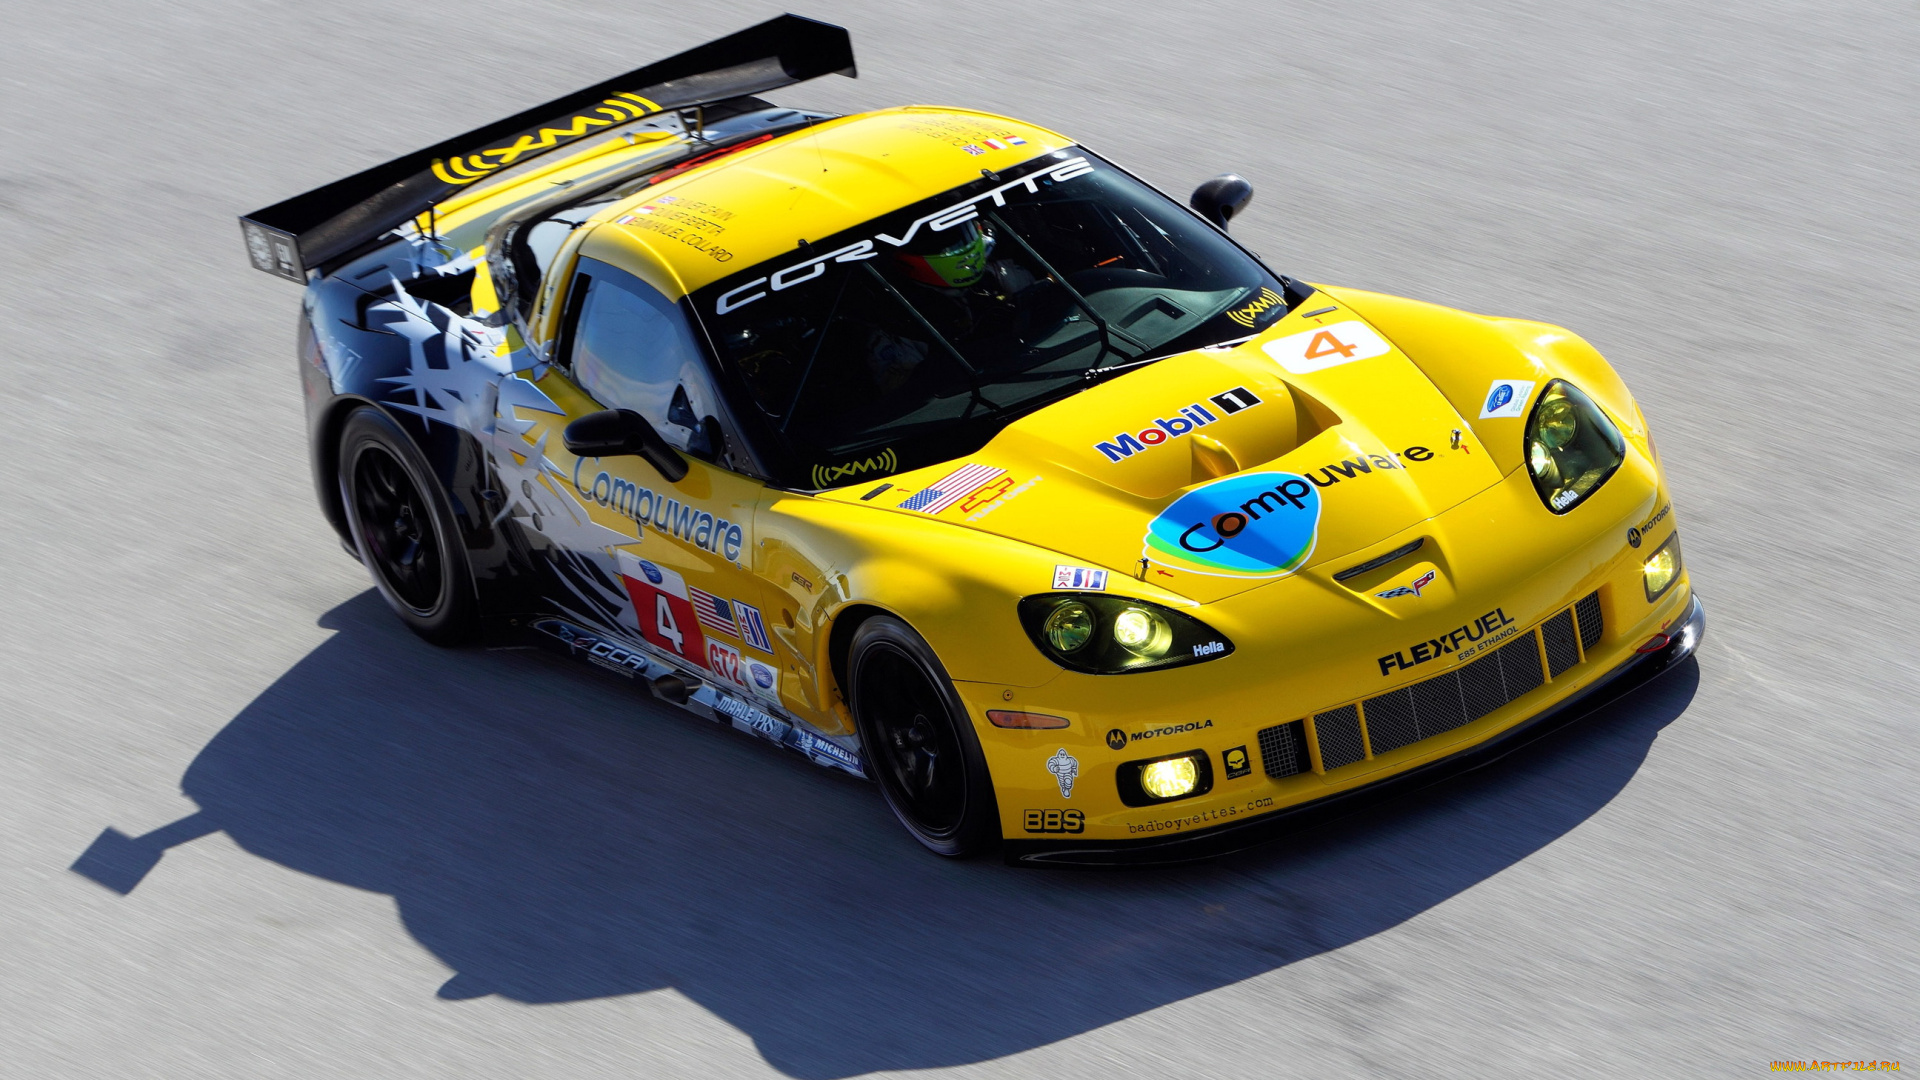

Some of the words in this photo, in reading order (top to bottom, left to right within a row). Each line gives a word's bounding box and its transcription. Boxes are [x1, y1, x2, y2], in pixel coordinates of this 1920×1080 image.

[680, 233, 734, 262] COLLARD
[716, 157, 1094, 315] CORVETTE
[1303, 330, 1358, 360] 4
[1094, 403, 1220, 463] Mobil
[573, 456, 744, 562] Compuware
[1179, 445, 1435, 552] Compuware
[1552, 489, 1579, 510] Hella
[656, 592, 685, 656] 4
[1377, 607, 1515, 677] FLEXFUEL
[1192, 641, 1225, 657] Hella
[1457, 647, 1476, 661] E85
[1477, 625, 1519, 650] ETHANOL
[709, 643, 745, 687] GT2
[716, 697, 755, 723] MAHLE
[1130, 719, 1214, 742] MOTOROLA
[814, 738, 859, 765] MICHELIN
[1023, 809, 1085, 833] BBS
[1127, 796, 1274, 834] badboyvettes.com
